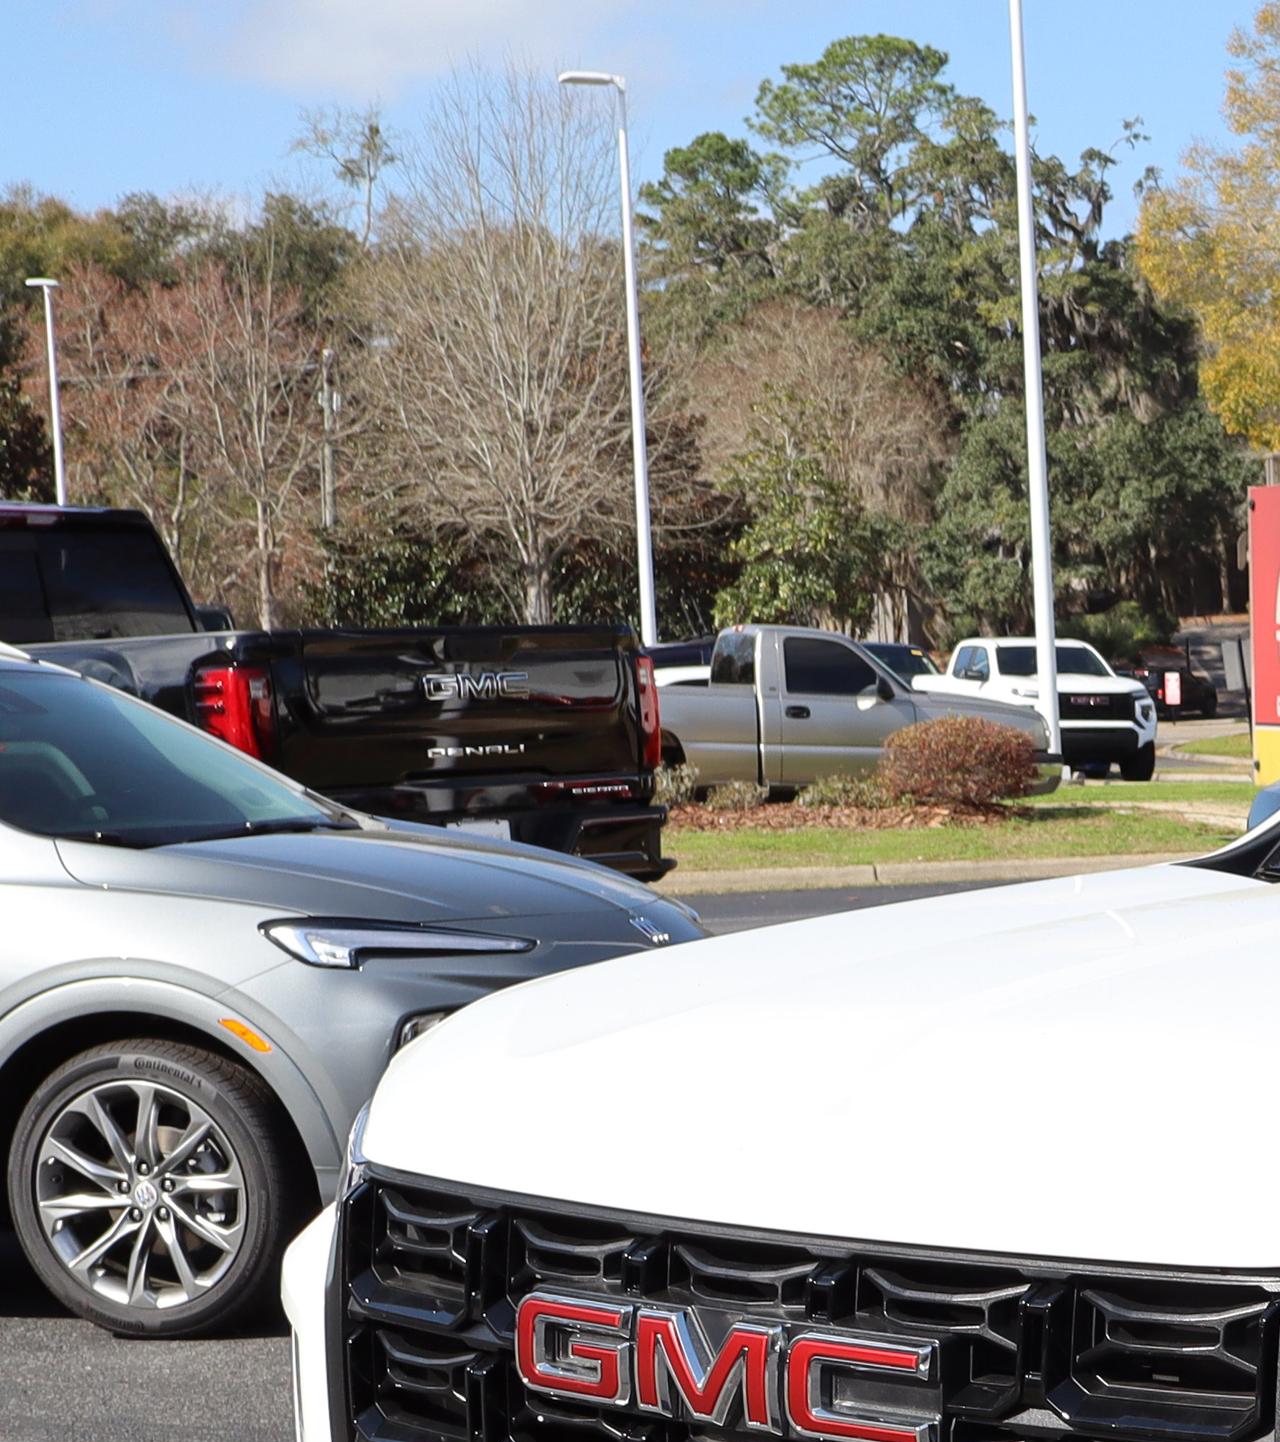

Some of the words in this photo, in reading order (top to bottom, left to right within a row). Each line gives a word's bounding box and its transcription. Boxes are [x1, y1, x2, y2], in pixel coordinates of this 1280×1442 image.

[423, 671, 529, 700] GMC
[428, 744, 524, 758] DENALI
[572, 785, 629, 794] SIERRA
[134, 1057, 195, 1086] Continental
